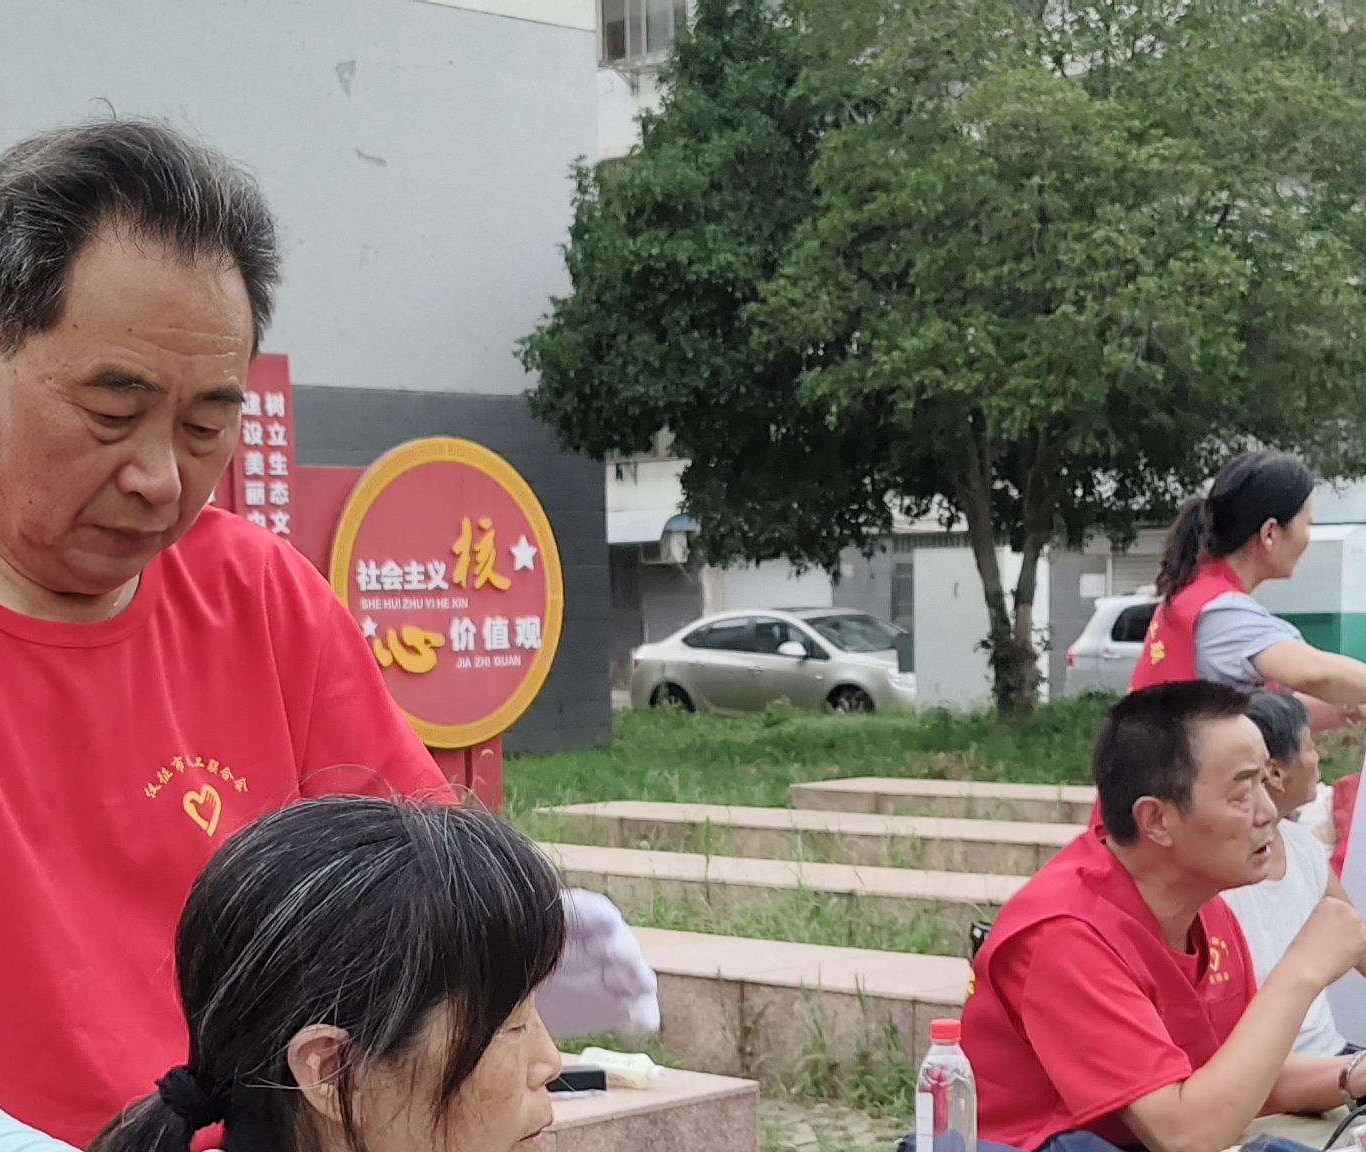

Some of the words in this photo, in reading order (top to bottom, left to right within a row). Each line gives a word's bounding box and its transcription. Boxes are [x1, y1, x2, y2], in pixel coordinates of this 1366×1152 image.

[264, 391, 292, 545] 树立生态文
[356, 558, 450, 592] 社会主义
[451, 516, 512, 591] 核
[361, 598, 382, 610] SHE
[383, 598, 402, 610] HUI
[403, 597, 424, 610] ZHU
[424, 597, 436, 610] YI
[436, 597, 450, 609] HE
[451, 597, 469, 609] XIN
[373, 625, 446, 674] 心
[450, 615, 542, 652] 价值观
[456, 656, 472, 669] JIA
[475, 656, 491, 668] ZHI
[495, 655, 522, 667] GUAN
